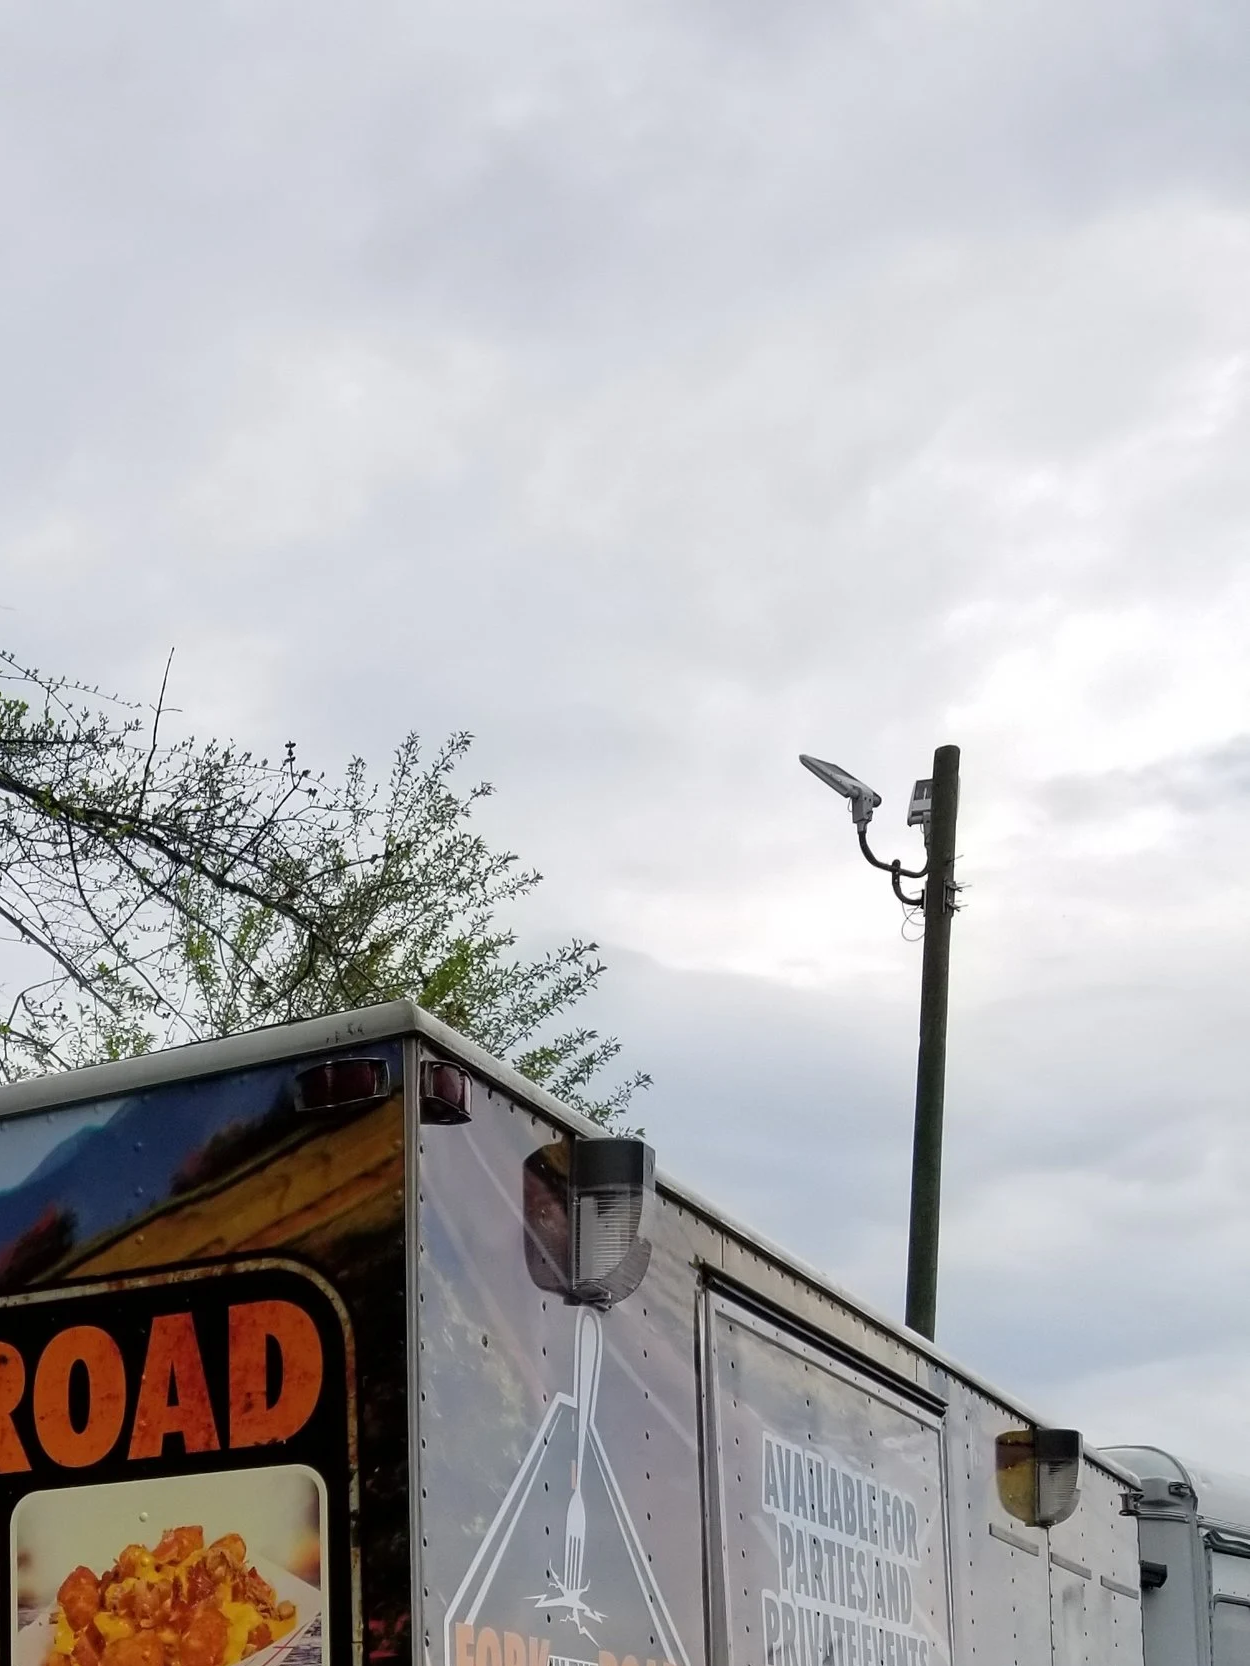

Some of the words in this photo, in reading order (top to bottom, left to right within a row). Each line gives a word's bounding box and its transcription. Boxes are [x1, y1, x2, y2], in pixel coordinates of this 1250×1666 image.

[764, 1439, 878, 1546] AVAILABLE
[882, 1489, 919, 1561] FOR
[779, 1521, 868, 1613] PARTIES
[874, 1557, 912, 1625] AND
